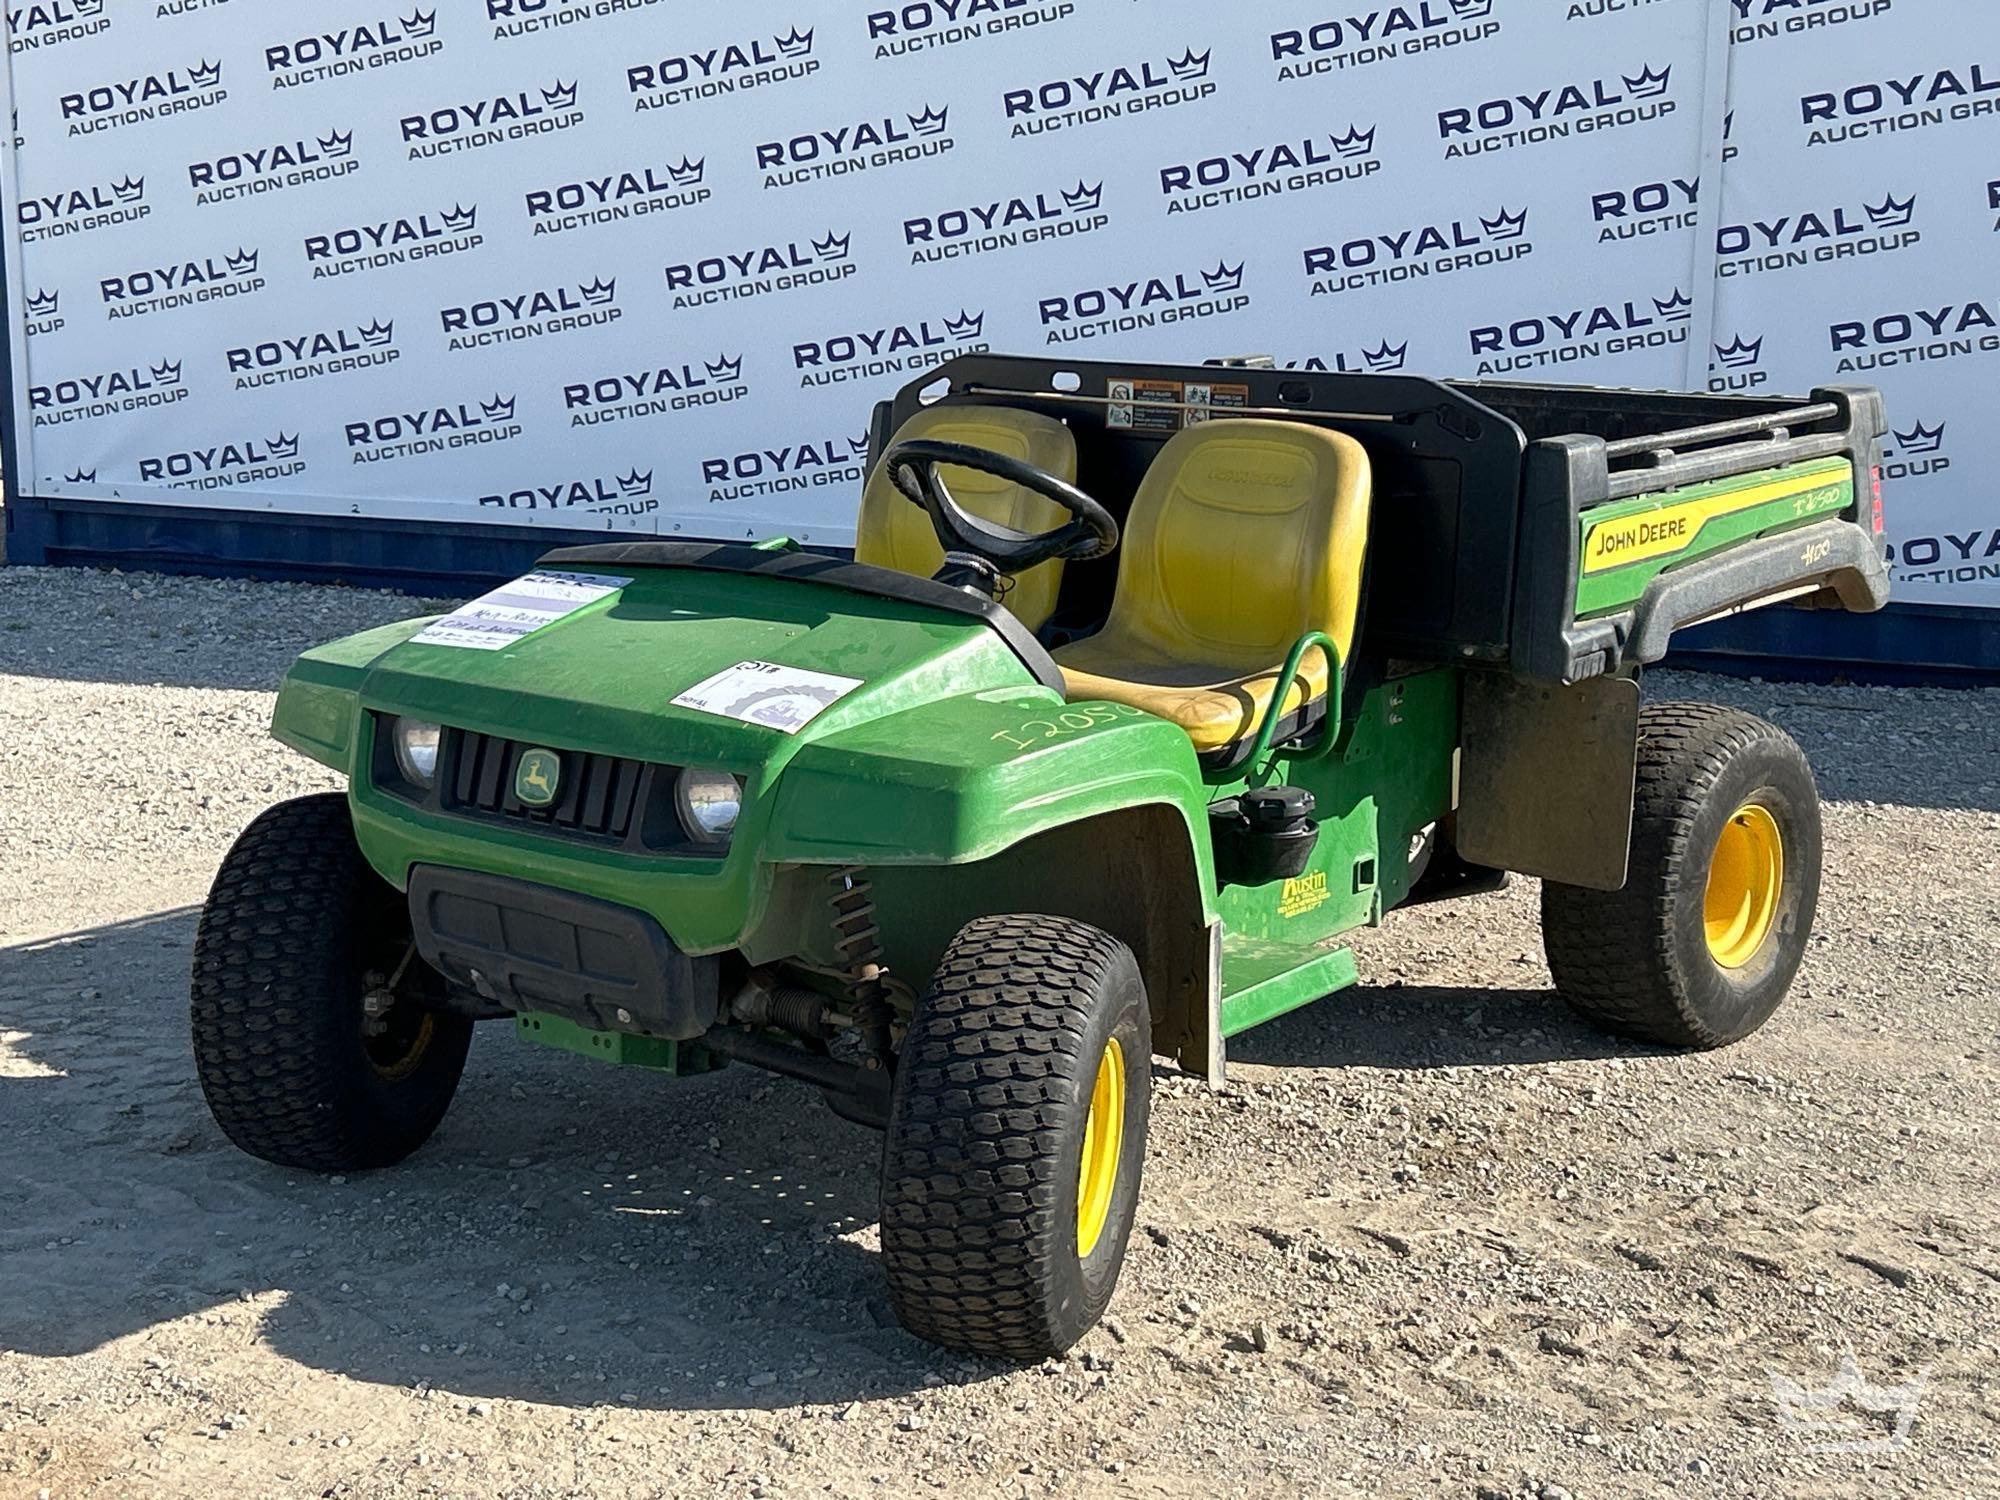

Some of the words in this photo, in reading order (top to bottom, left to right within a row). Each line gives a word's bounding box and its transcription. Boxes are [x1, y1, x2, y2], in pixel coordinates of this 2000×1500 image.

[7, 1, 74, 34] YAL
[43, 19, 110, 45] GROUP
[494, 5, 591, 40] AUCTION
[595, 0, 664, 16] GRO
[875, 23, 981, 59] AUCTION
[987, 3, 1074, 34] GROUP
[1271, 1, 1448, 60] ROYAL
[1785, 0, 1891, 32] GROUP
[265, 22, 402, 71] ROYAL
[273, 58, 364, 90] AUCTION
[368, 40, 443, 68] GROUP
[627, 41, 776, 92] ROYAL
[1278, 43, 1397, 81] AUCTION
[1403, 22, 1500, 54] GROUP
[60, 72, 190, 119] ROYAL
[635, 79, 734, 112] AUCTION
[739, 60, 820, 89] GROUP
[1004, 62, 1168, 118] ROYAL
[1438, 80, 1622, 138] ROYAL
[1801, 65, 2000, 124] ROYAL
[69, 107, 154, 137] AUCTION
[158, 90, 227, 116] GROUP
[400, 93, 543, 142] ROYAL
[1011, 102, 1121, 138] AUCTION
[1127, 83, 1216, 113] GROUP
[1445, 122, 1569, 160] AUCTION
[1576, 101, 1676, 133] GROUP
[1807, 108, 1943, 147] AUCTION
[409, 129, 504, 161] AUCTION
[508, 112, 584, 139] GROUP
[756, 119, 909, 169] ROYAL
[189, 141, 320, 187] ROYAL
[197, 176, 283, 206] AUCTION
[287, 160, 359, 186] GROUP
[764, 156, 866, 189] AUCTION
[871, 139, 954, 167] GROUP
[1160, 139, 1331, 194] ROYAL
[17, 187, 113, 224] OYAL
[526, 169, 669, 217] ROYAL
[1167, 179, 1281, 215] AUCTION
[1287, 160, 1380, 190] GROUP
[1592, 176, 1700, 221] ROY
[20, 220, 79, 244] CTION
[83, 205, 150, 230] GROUP
[534, 205, 629, 236] AUCTION
[633, 189, 711, 215] GROUP
[904, 194, 1062, 245] ROYAL
[1716, 208, 1864, 255] OYAL
[305, 216, 443, 261] ROYAL
[313, 250, 405, 279] AUCTION
[409, 235, 483, 260] GROUP
[912, 232, 1017, 265] AUCTION
[1022, 215, 1108, 243] GROUP
[1304, 222, 1480, 275] ROYAL
[1715, 250, 1807, 279] CTION
[1814, 231, 1920, 262] GROUP
[100, 259, 227, 302] ROYAL
[665, 243, 813, 291] ROYAL
[673, 280, 772, 310] AUCTION
[776, 264, 856, 290] GROUP
[1311, 262, 1429, 296] AUCTION
[1435, 243, 1532, 273] GROUP
[109, 292, 193, 320] AUCTION
[197, 278, 265, 302] GROUP
[441, 288, 581, 333] ROYAL
[1039, 274, 1202, 325] ROYAL
[1046, 312, 1155, 345] AUCTION
[1160, 295, 1249, 323] GROUP
[26, 319, 64, 336] OUP
[449, 323, 542, 351] AUCTION
[547, 308, 621, 333] GROUP
[793, 322, 945, 368] ROYAL
[1470, 302, 1653, 355] ROYAL
[1830, 302, 1997, 351] ROYA
[227, 330, 360, 372] ROYAL
[235, 363, 324, 390] AUCTION
[328, 350, 400, 373] GROUP
[801, 358, 902, 388] AUCTION
[1477, 342, 1600, 376] AUCTION
[1606, 327, 1690, 353] GROU
[1836, 339, 1972, 374] AUCTION
[29, 369, 152, 409] ROYAL
[564, 365, 706, 409] ROYAL
[1708, 371, 1767, 392] OUP
[34, 401, 119, 427] AUCTION
[123, 389, 188, 410] GROUP
[345, 405, 482, 446] ROYAL
[571, 400, 666, 427] AUCTION
[671, 386, 748, 410] GROUP
[139, 442, 268, 482] ROYAL
[353, 438, 444, 464] AUCTION
[448, 425, 521, 448] GROUP
[702, 441, 849, 484] ROYAL
[236, 462, 306, 483] GROUP
[710, 475, 808, 503] AUCTION
[812, 467, 864, 486] GRO
[1597, 529, 1636, 556] JOHN
[1639, 517, 1687, 546] DEERE
